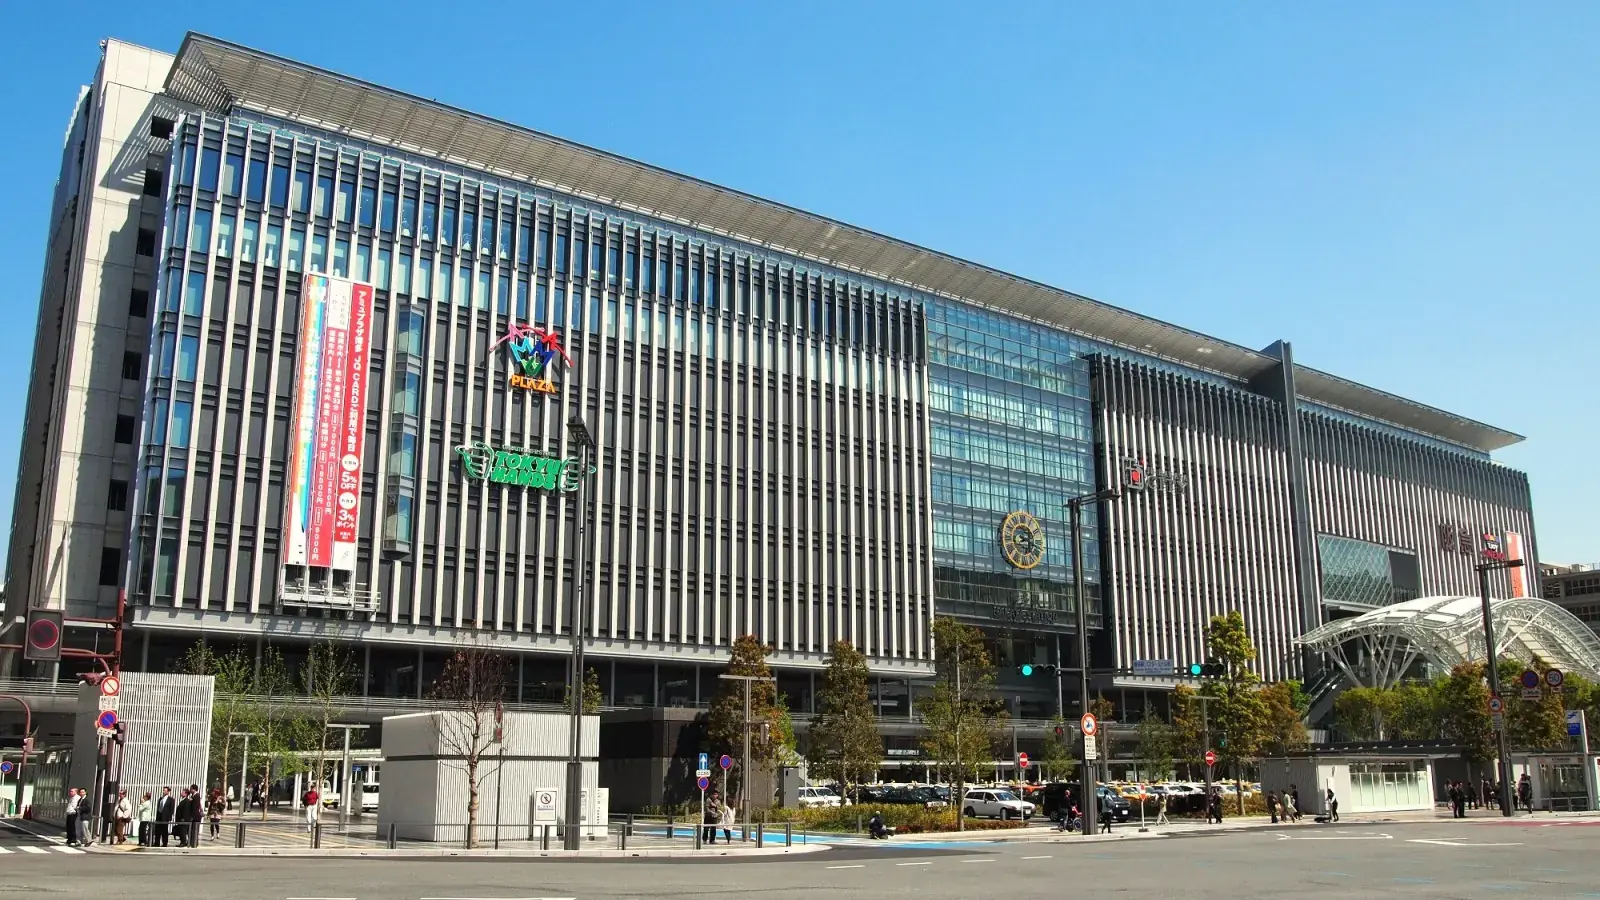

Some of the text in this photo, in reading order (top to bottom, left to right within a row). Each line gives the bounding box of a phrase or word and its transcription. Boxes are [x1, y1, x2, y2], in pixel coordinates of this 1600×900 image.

[511, 374, 556, 394] PLAZA
[494, 450, 561, 475] TOKYU
[342, 472, 357, 484] 5%
[490, 467, 556, 490] HANDS
[338, 508, 354, 521] 3%
[336, 520, 355, 529] ポイント
